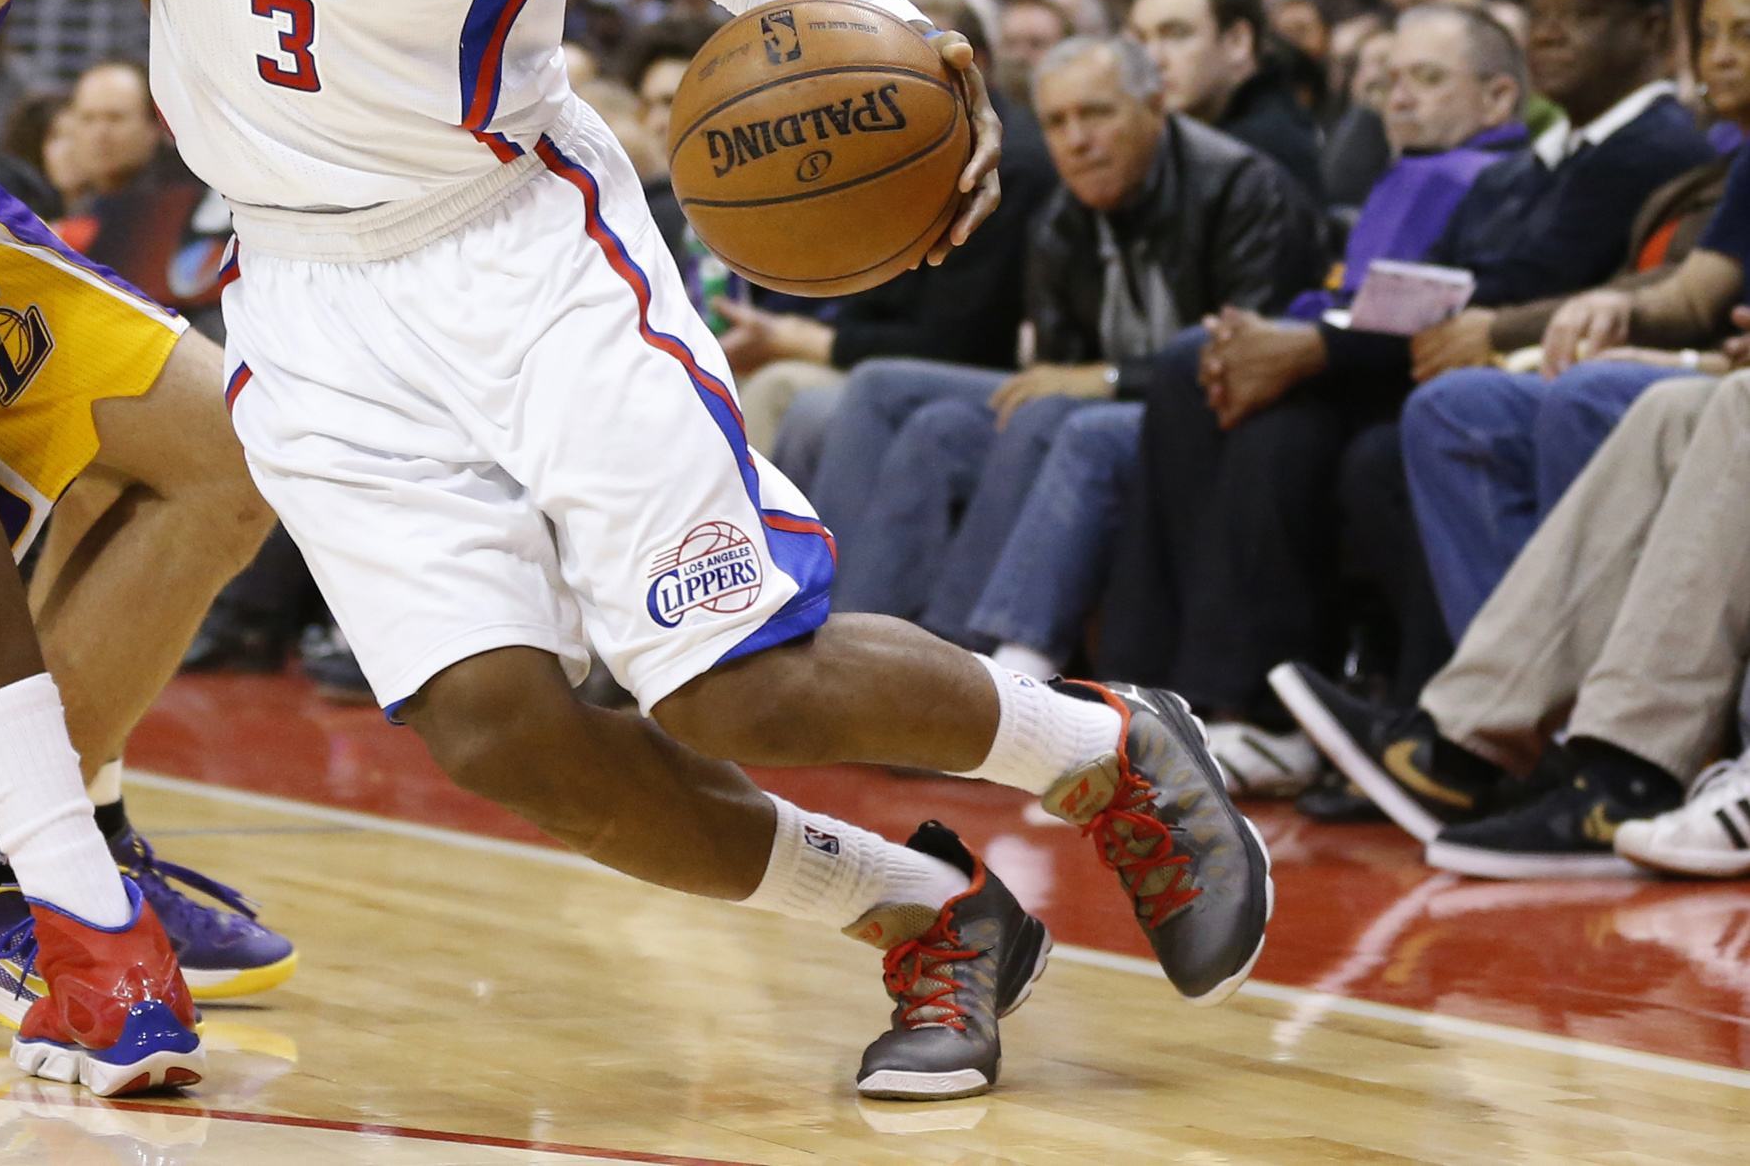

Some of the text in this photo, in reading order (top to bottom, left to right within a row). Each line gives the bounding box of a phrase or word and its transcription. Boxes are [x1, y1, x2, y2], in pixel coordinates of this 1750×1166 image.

[706, 82, 907, 179] SPALDING
[646, 558, 757, 629] CLIPPERS
[684, 546, 751, 576] LOS ANGELES
